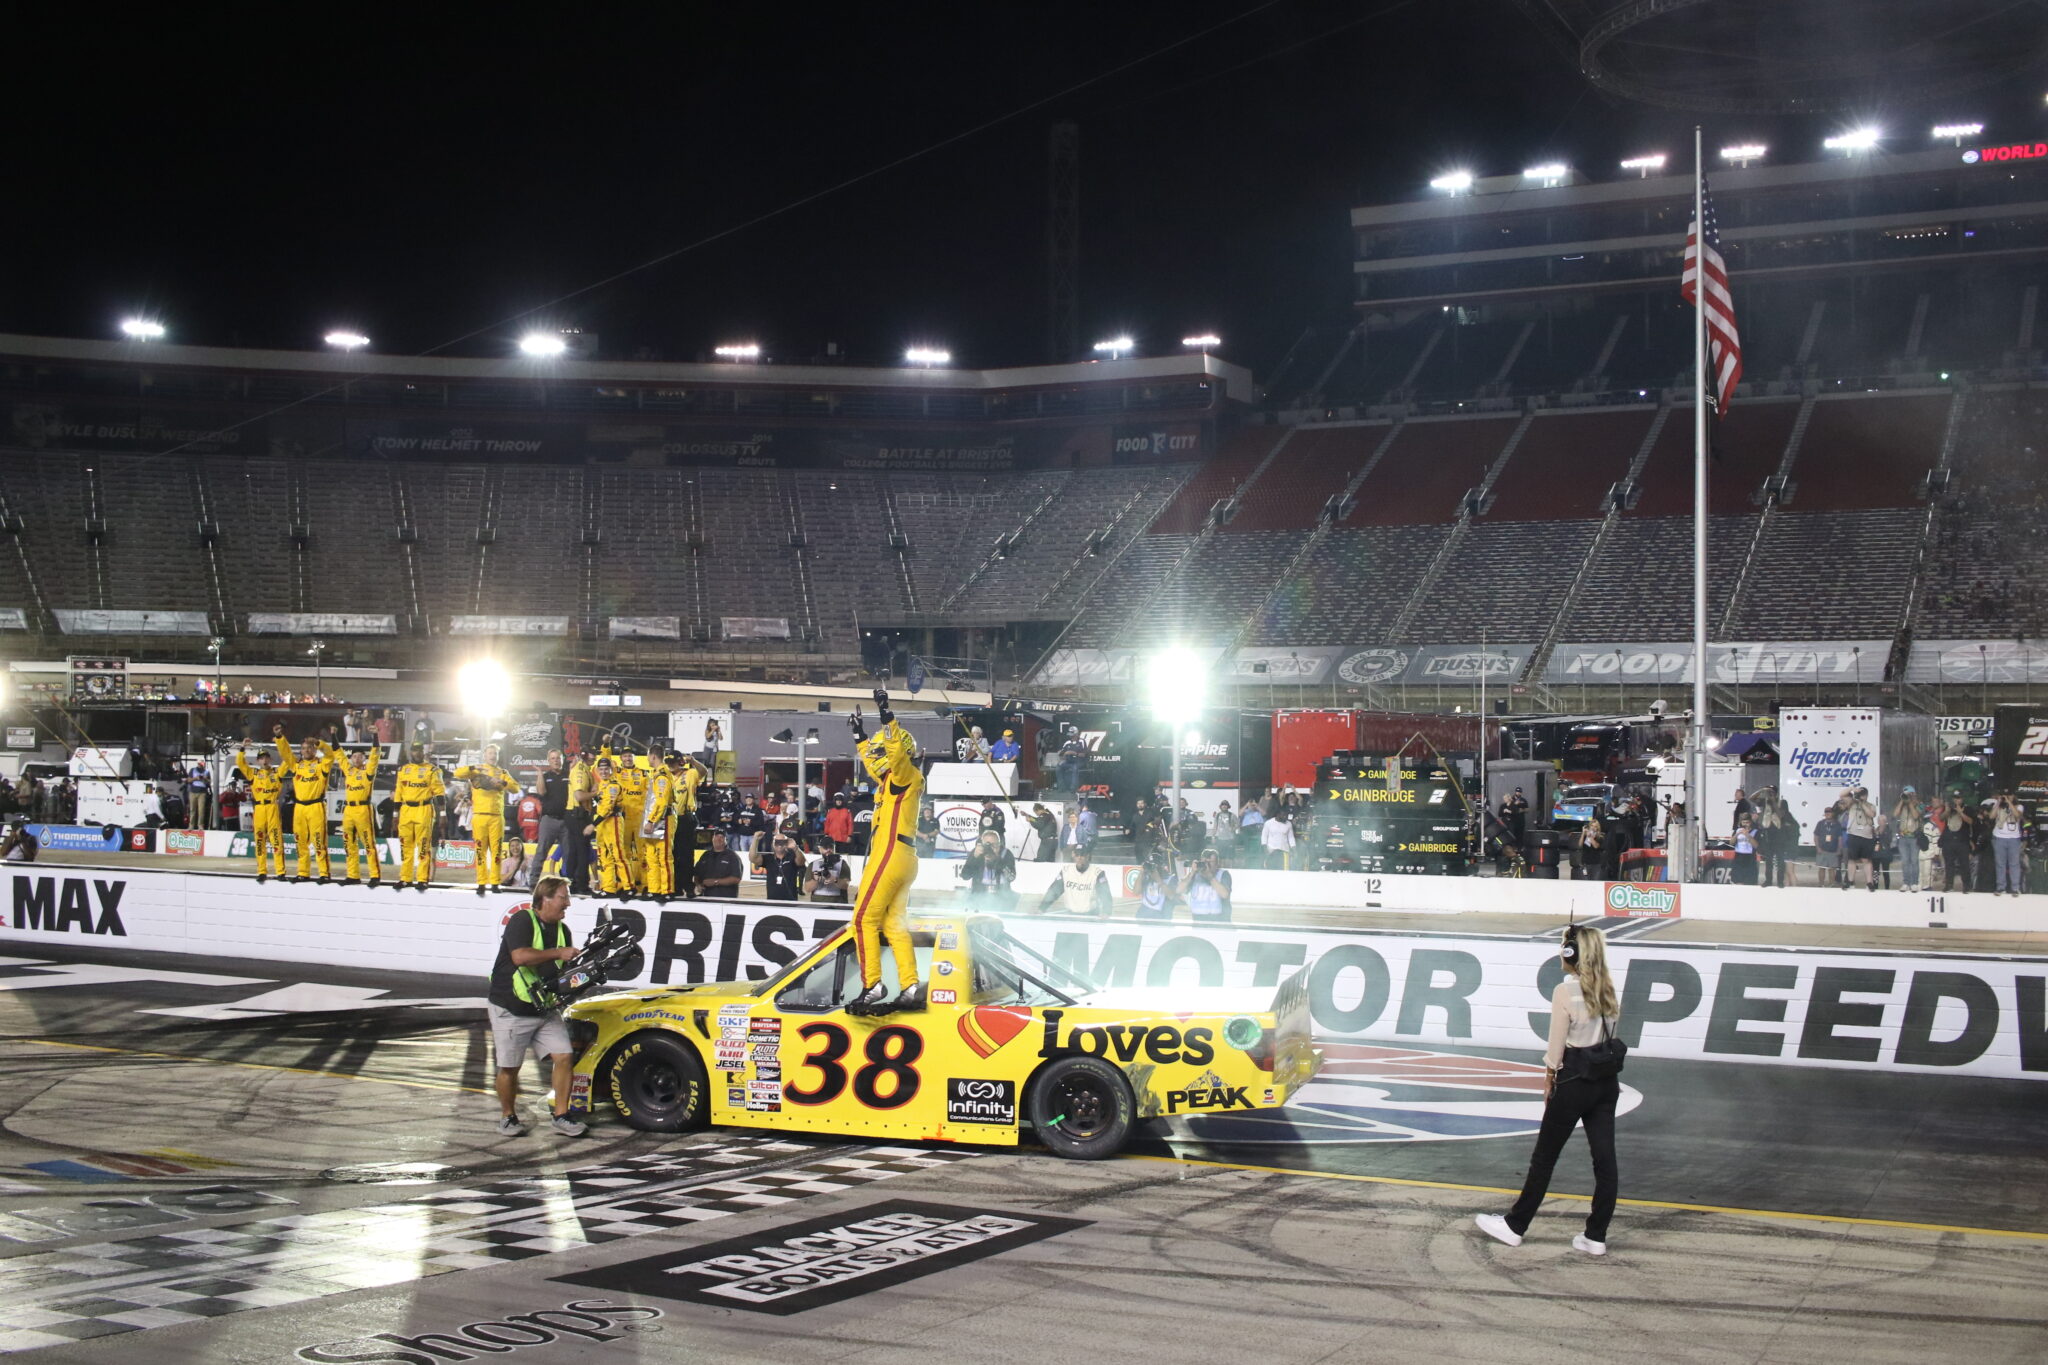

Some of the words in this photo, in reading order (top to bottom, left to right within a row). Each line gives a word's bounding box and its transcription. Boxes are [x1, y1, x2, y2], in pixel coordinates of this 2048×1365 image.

[1981, 143, 2048, 163] WORLD
[378, 435, 418, 449] TONY
[420, 436, 481, 451] HELMET
[486, 438, 542, 453] THROW
[662, 442, 736, 457] COLOSSUS
[740, 443, 762, 457] TV
[1116, 437, 1147, 453] FOOD
[1168, 434, 1197, 449] CITY
[879, 447, 932, 459] BATTLE
[937, 448, 955, 459] AT
[958, 447, 1014, 460] BRISTOL
[1429, 654, 1514, 672] BUSH'S
[1566, 652, 1676, 674] FOOD
[1756, 651, 1867, 673] CITY
[2018, 726, 2048, 755] 2
[1789, 747, 1870, 770] Hendrick
[1368, 769, 1417, 780] GAINDGE
[1801, 765, 1864, 778] Cars.com
[1343, 789, 1416, 803] GAINBRIDGE
[1428, 788, 1449, 805] 2
[946, 816, 978, 828] YOUNG'S
[1408, 842, 1458, 853] GAINBRIDGE
[1065, 880, 1092, 892] OFFICIAL
[1364, 878, 1382, 894] 12
[13, 875, 128, 937] MAX
[1610, 885, 1674, 911] O'Reilly
[1050, 930, 1484, 1039] MOTOR
[932, 990, 956, 1002] SEM
[623, 1009, 685, 1023] GOODYEAR
[718, 1017, 748, 1027] SKF
[714, 1039, 746, 1049] CALICO
[715, 1060, 746, 1069] JESEL
[782, 1020, 926, 1110] 38
[610, 1043, 643, 1118] GOODYEAR
[749, 1080, 780, 1089] tilton
[683, 1080, 699, 1122] EAGLE
[747, 1101, 769, 1112] Holley
[1166, 1086, 1255, 1113] PEAK
[947, 1099, 1014, 1120] Infinity
[949, 1113, 993, 1122] Communications
[995, 1115, 1013, 1123] Group
[662, 1211, 957, 1282] TRACKER
[737, 1251, 886, 1296] BOATS
[294, 1298, 664, 1365] Shops
